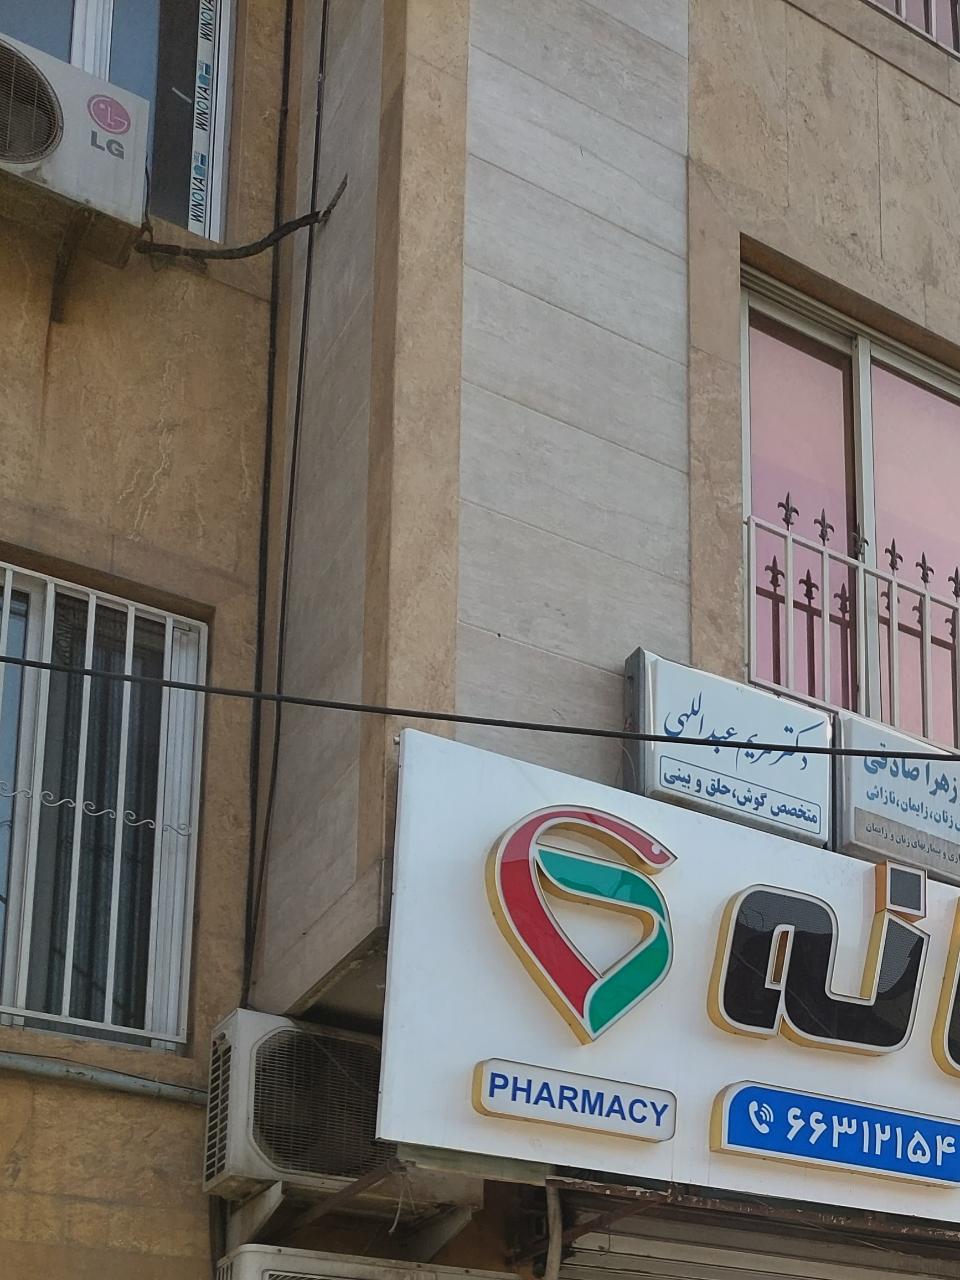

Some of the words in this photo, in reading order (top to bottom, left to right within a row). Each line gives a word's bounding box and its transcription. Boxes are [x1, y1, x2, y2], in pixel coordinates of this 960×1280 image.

[195, 86, 210, 132] WINOVA
[91, 130, 125, 160] LG
[190, 176, 206, 224] WINOVA
[663, 768, 691, 790] بینی
[695, 779, 702, 794] و
[925, 761, 958, 804] زهرا
[771, 803, 818, 825] متخصص
[488, 1071, 670, 1128] PHARMACY
[786, 1105, 956, 1166] ۶۶۳۱۲۱۵۴
